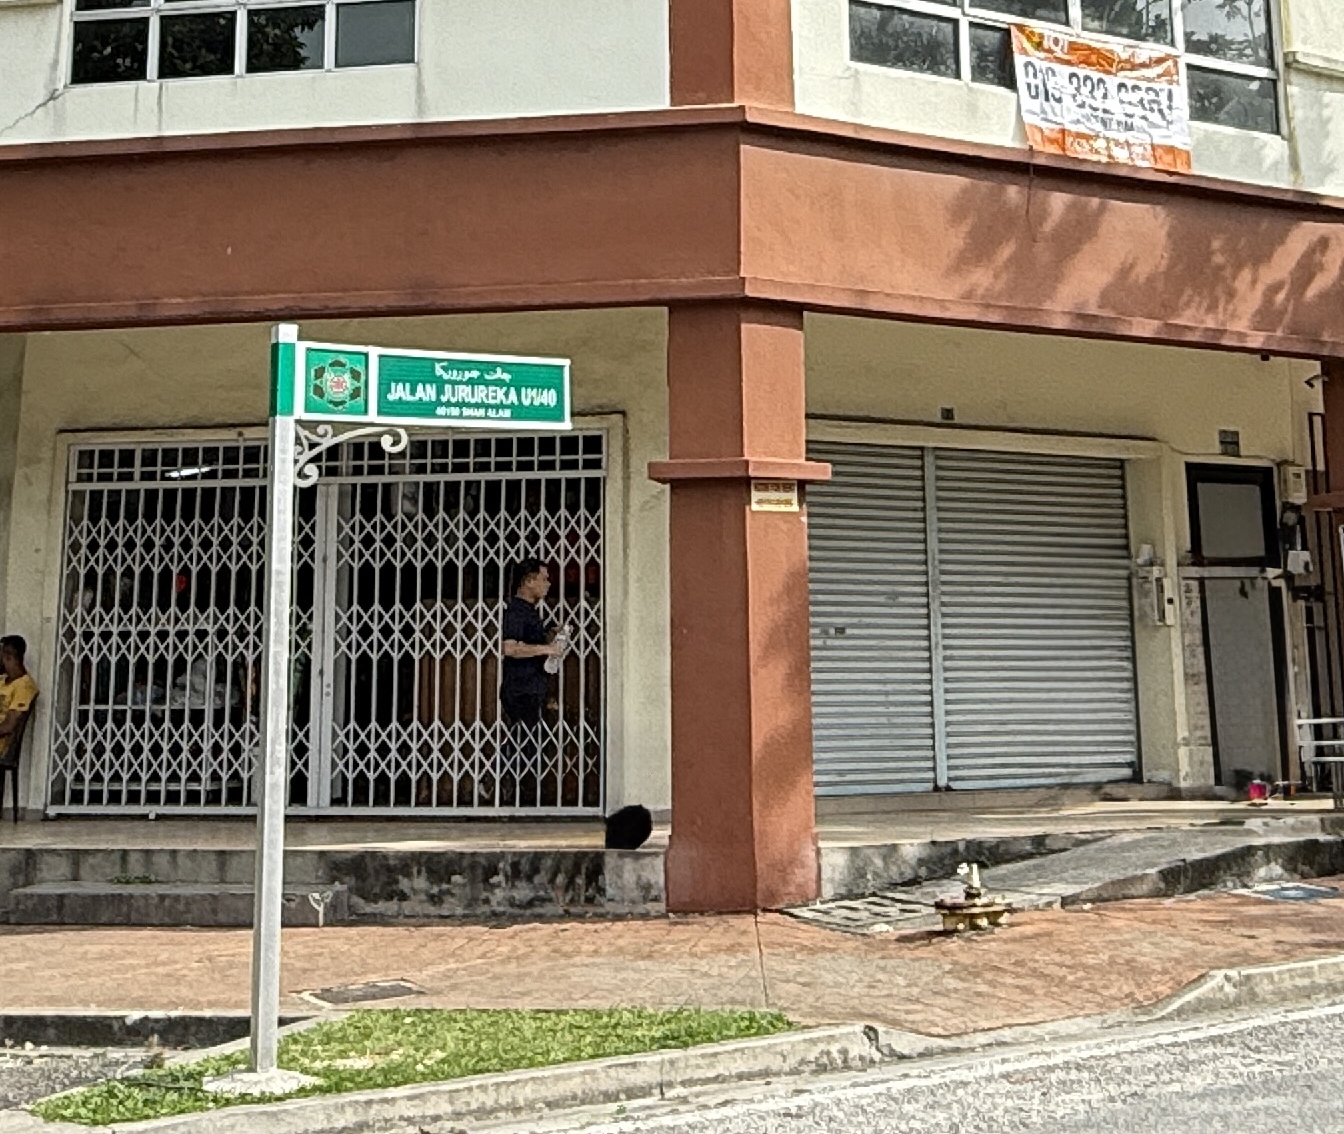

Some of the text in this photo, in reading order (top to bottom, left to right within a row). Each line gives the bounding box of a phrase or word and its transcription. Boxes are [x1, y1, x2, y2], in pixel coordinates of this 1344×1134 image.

[386, 381, 558, 408] JALAN JURUREKA U1/40
[461, 407, 485, 417] SHAH
[486, 408, 512, 418] ALAM
